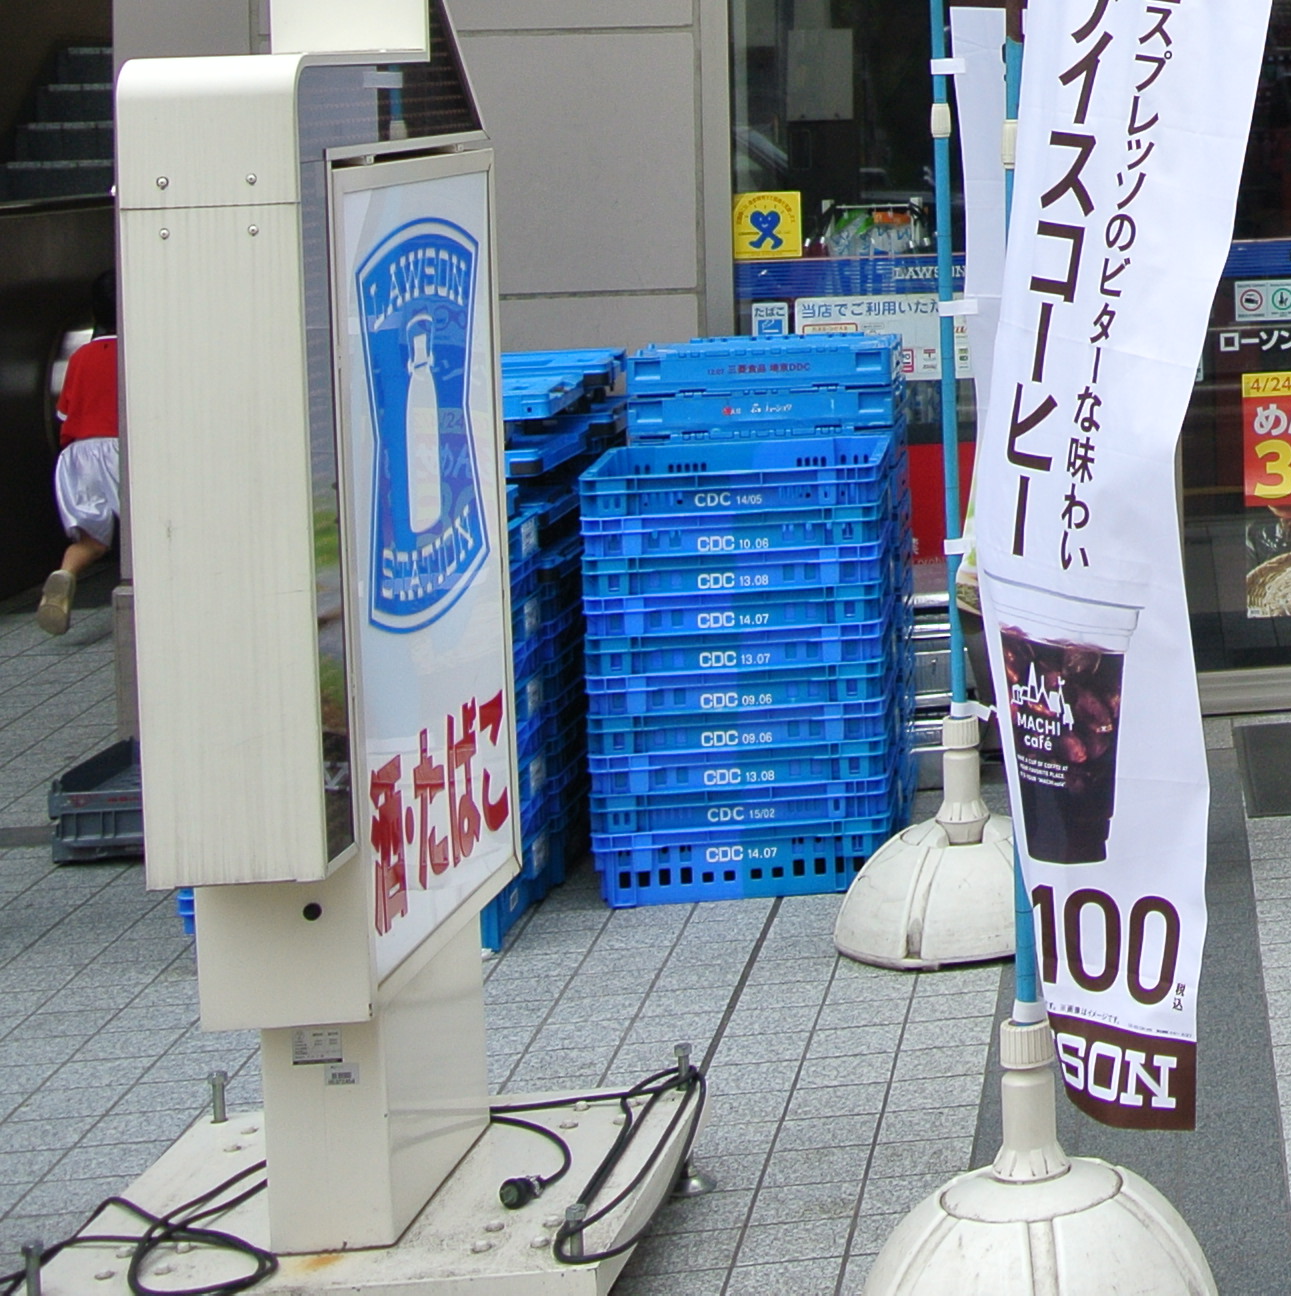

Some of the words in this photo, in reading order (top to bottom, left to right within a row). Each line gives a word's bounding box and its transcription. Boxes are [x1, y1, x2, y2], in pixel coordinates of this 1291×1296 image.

[370, 247, 467, 331] LAWSON
[754, 306, 786, 318] たばこ
[694, 492, 731, 506] CDC
[736, 494, 762, 504] 14/05
[697, 535, 735, 551] CDC
[739, 538, 769, 549] 10.06
[382, 504, 474, 602] STATION
[697, 572, 735, 589] CDC
[739, 575, 769, 586] 13.08
[697, 612, 735, 629] CDC
[739, 614, 769, 625] 14.07
[699, 651, 737, 667] CDC
[741, 653, 770, 664] 13.07
[700, 692, 738, 708] CDC
[742, 694, 772, 705] 09.06
[1017, 712, 1061, 736] MACHI
[701, 730, 738, 747] CDC
[742, 732, 772, 744] 09.06
[1024, 734, 1053, 751] café
[704, 769, 741, 785] CDC
[745, 770, 775, 782] 13.08
[707, 807, 744, 822] CDC
[750, 808, 775, 819] 15/02
[706, 846, 743, 862] CDC
[747, 847, 777, 859] 14.07
[1172, 982, 1187, 1011] 税込
[1053, 1029, 1178, 1109] SON
